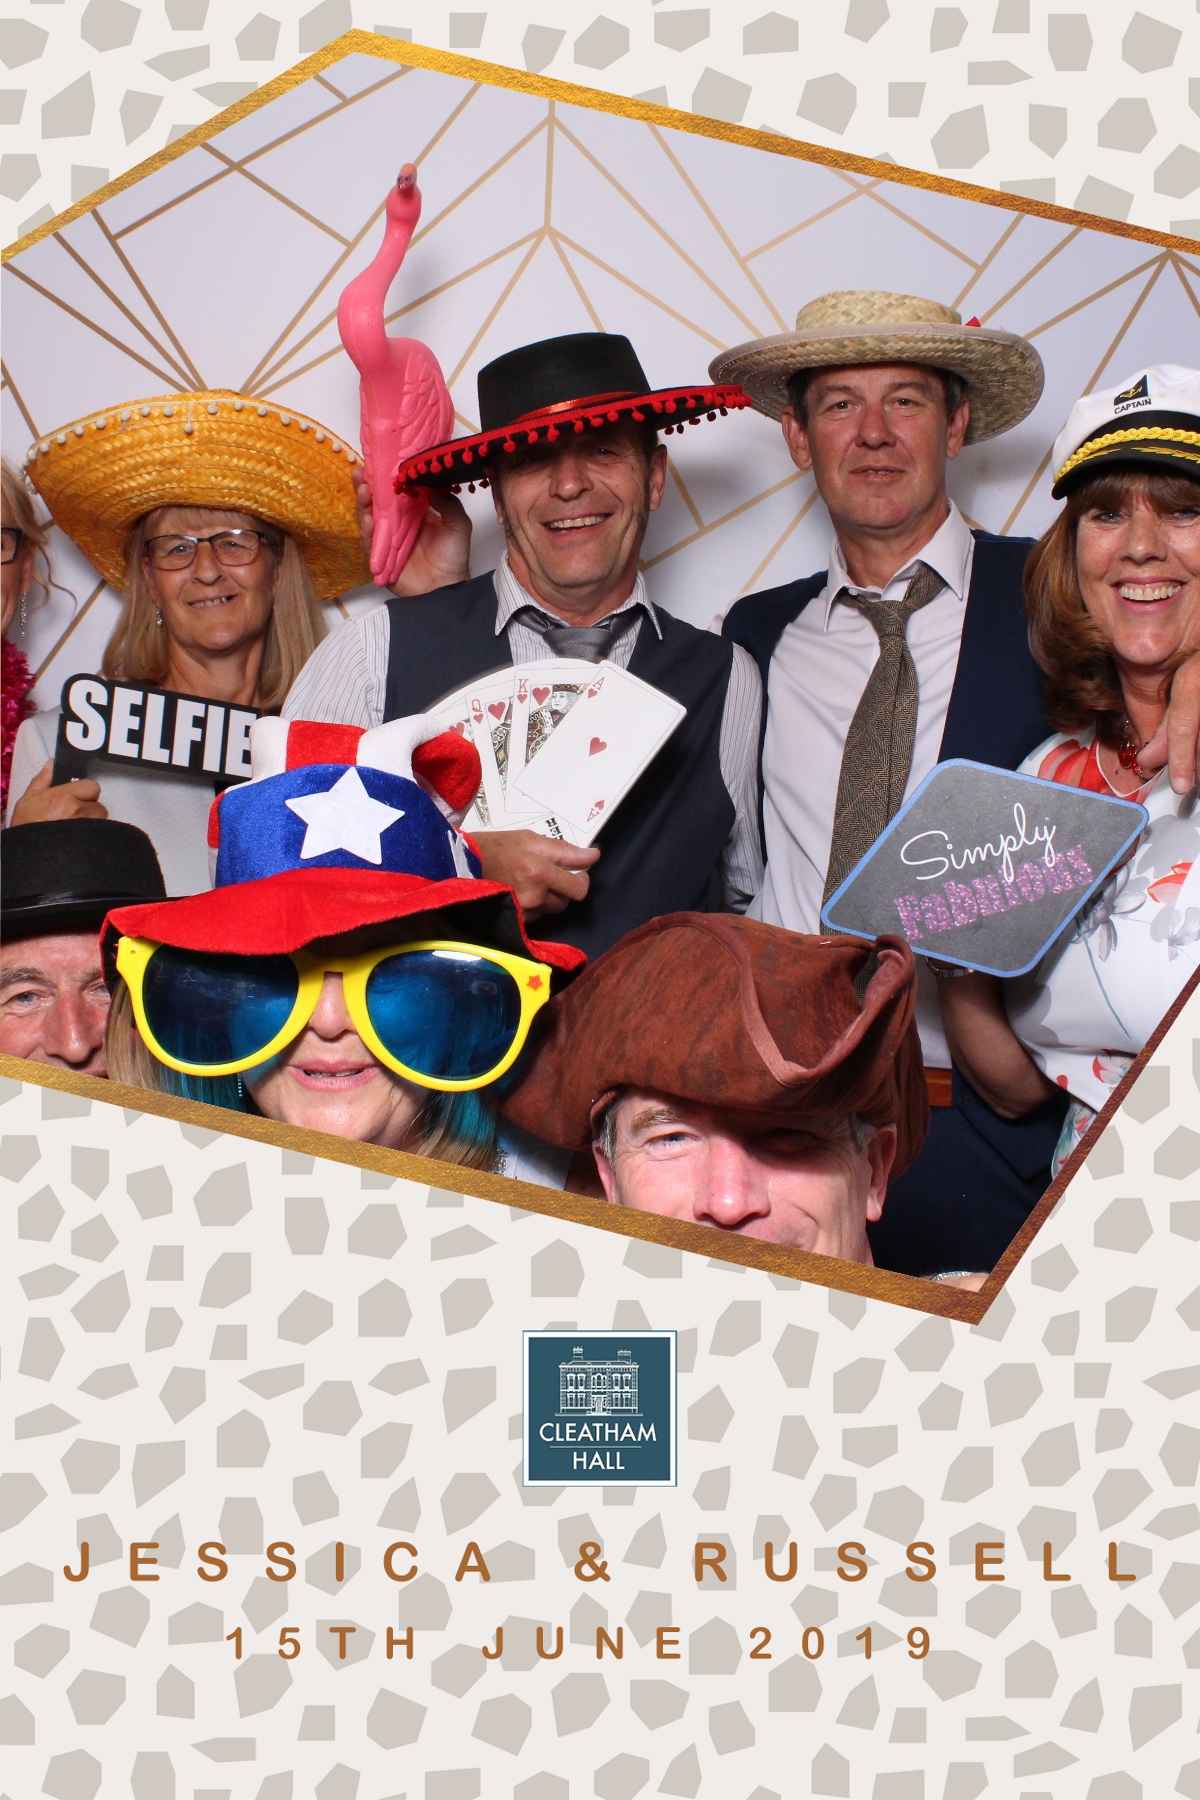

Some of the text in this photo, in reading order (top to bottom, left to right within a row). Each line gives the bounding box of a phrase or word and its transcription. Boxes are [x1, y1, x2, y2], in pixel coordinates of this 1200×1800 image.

[1114, 398, 1151, 415] CAPTAIN
[471, 698, 483, 713] Q
[517, 679, 529, 693] K
[65, 679, 257, 779] SELFIE
[900, 802, 1057, 883] Simply
[893, 844, 1094, 941] Fabulous
